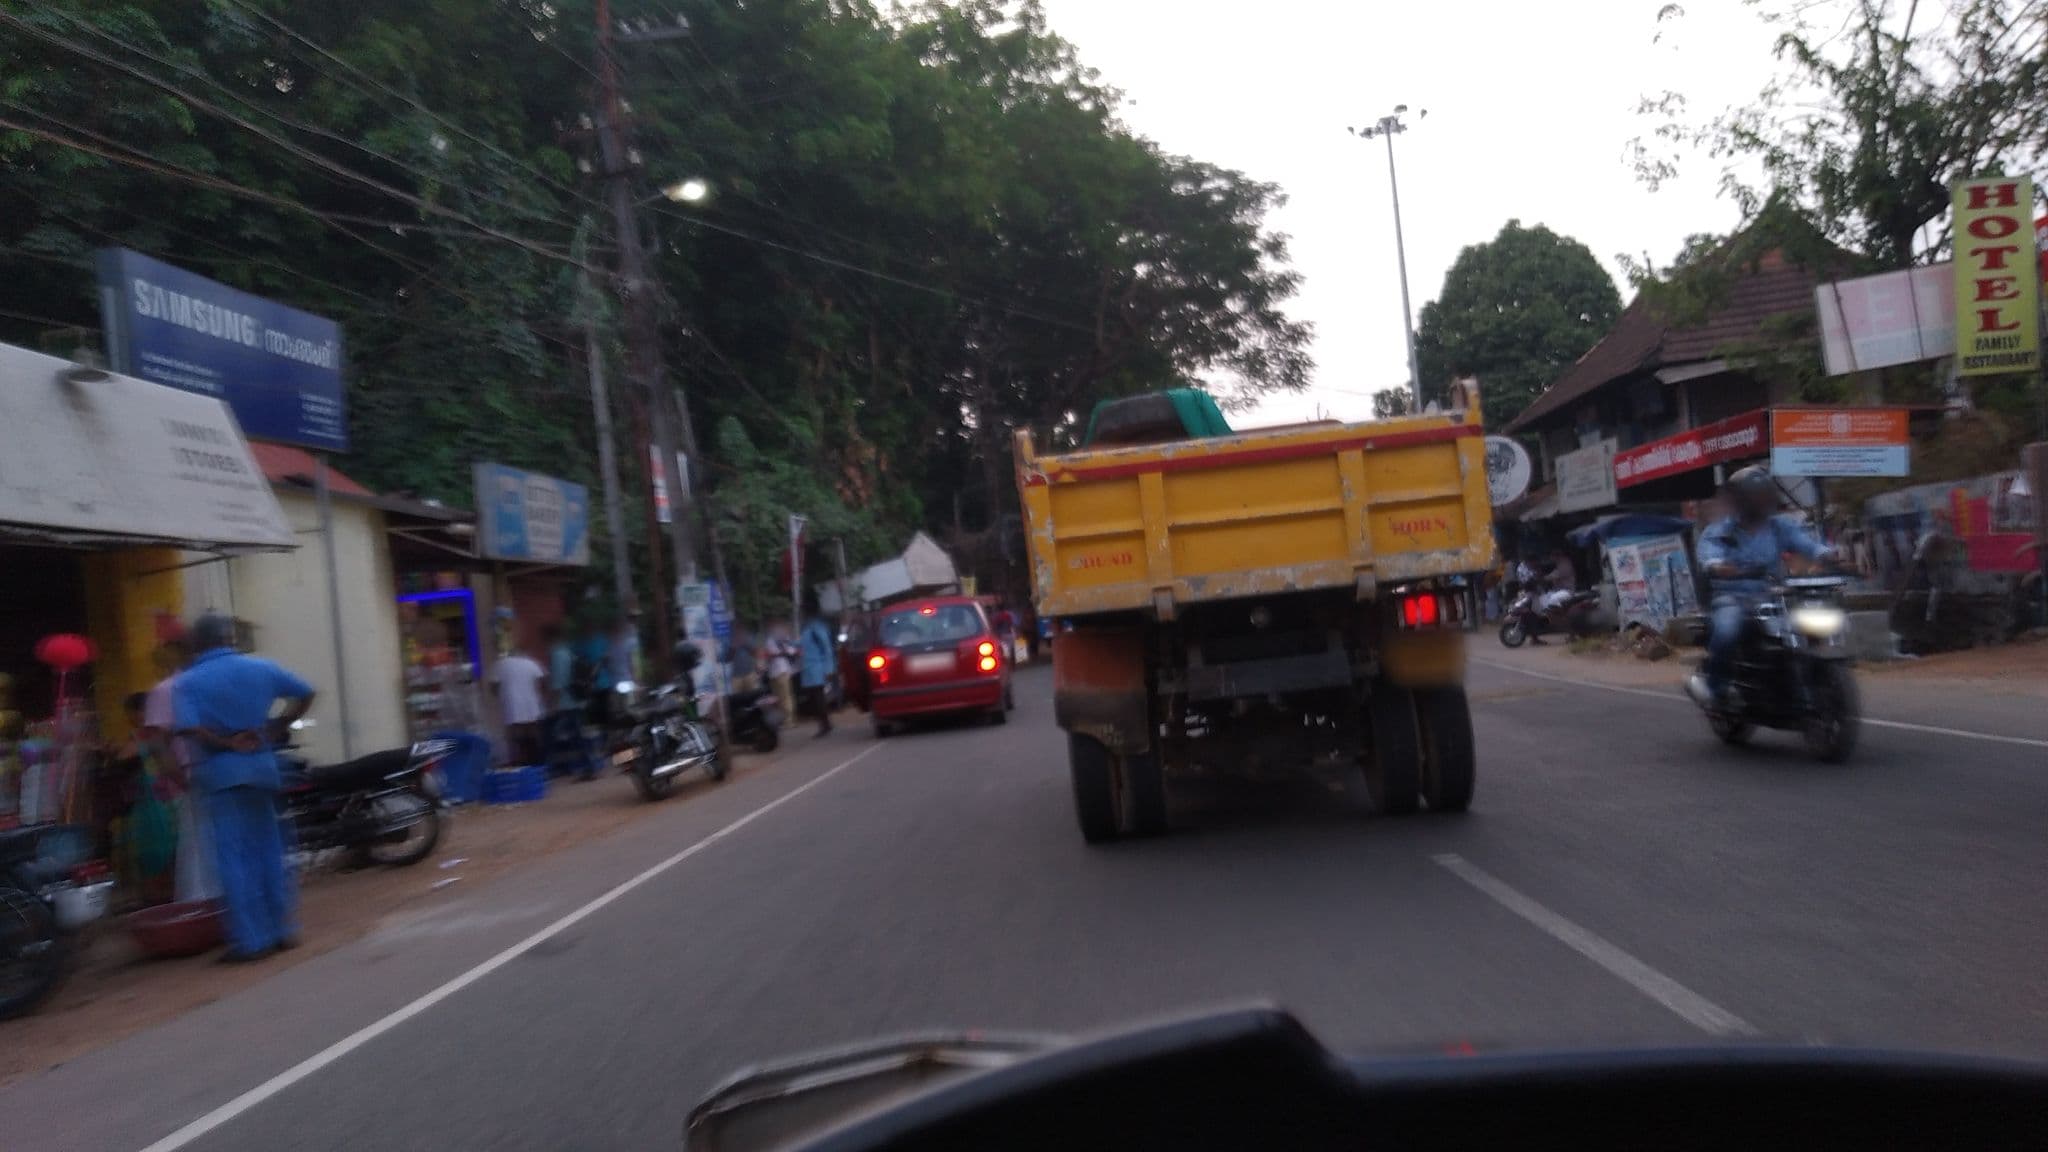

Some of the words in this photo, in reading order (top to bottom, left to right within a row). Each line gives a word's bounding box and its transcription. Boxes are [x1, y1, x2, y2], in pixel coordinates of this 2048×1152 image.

[1966, 183, 2021, 332] HOTEL
[134, 280, 260, 346] SAMSUNG
[1975, 335, 2021, 350] FAMILY
